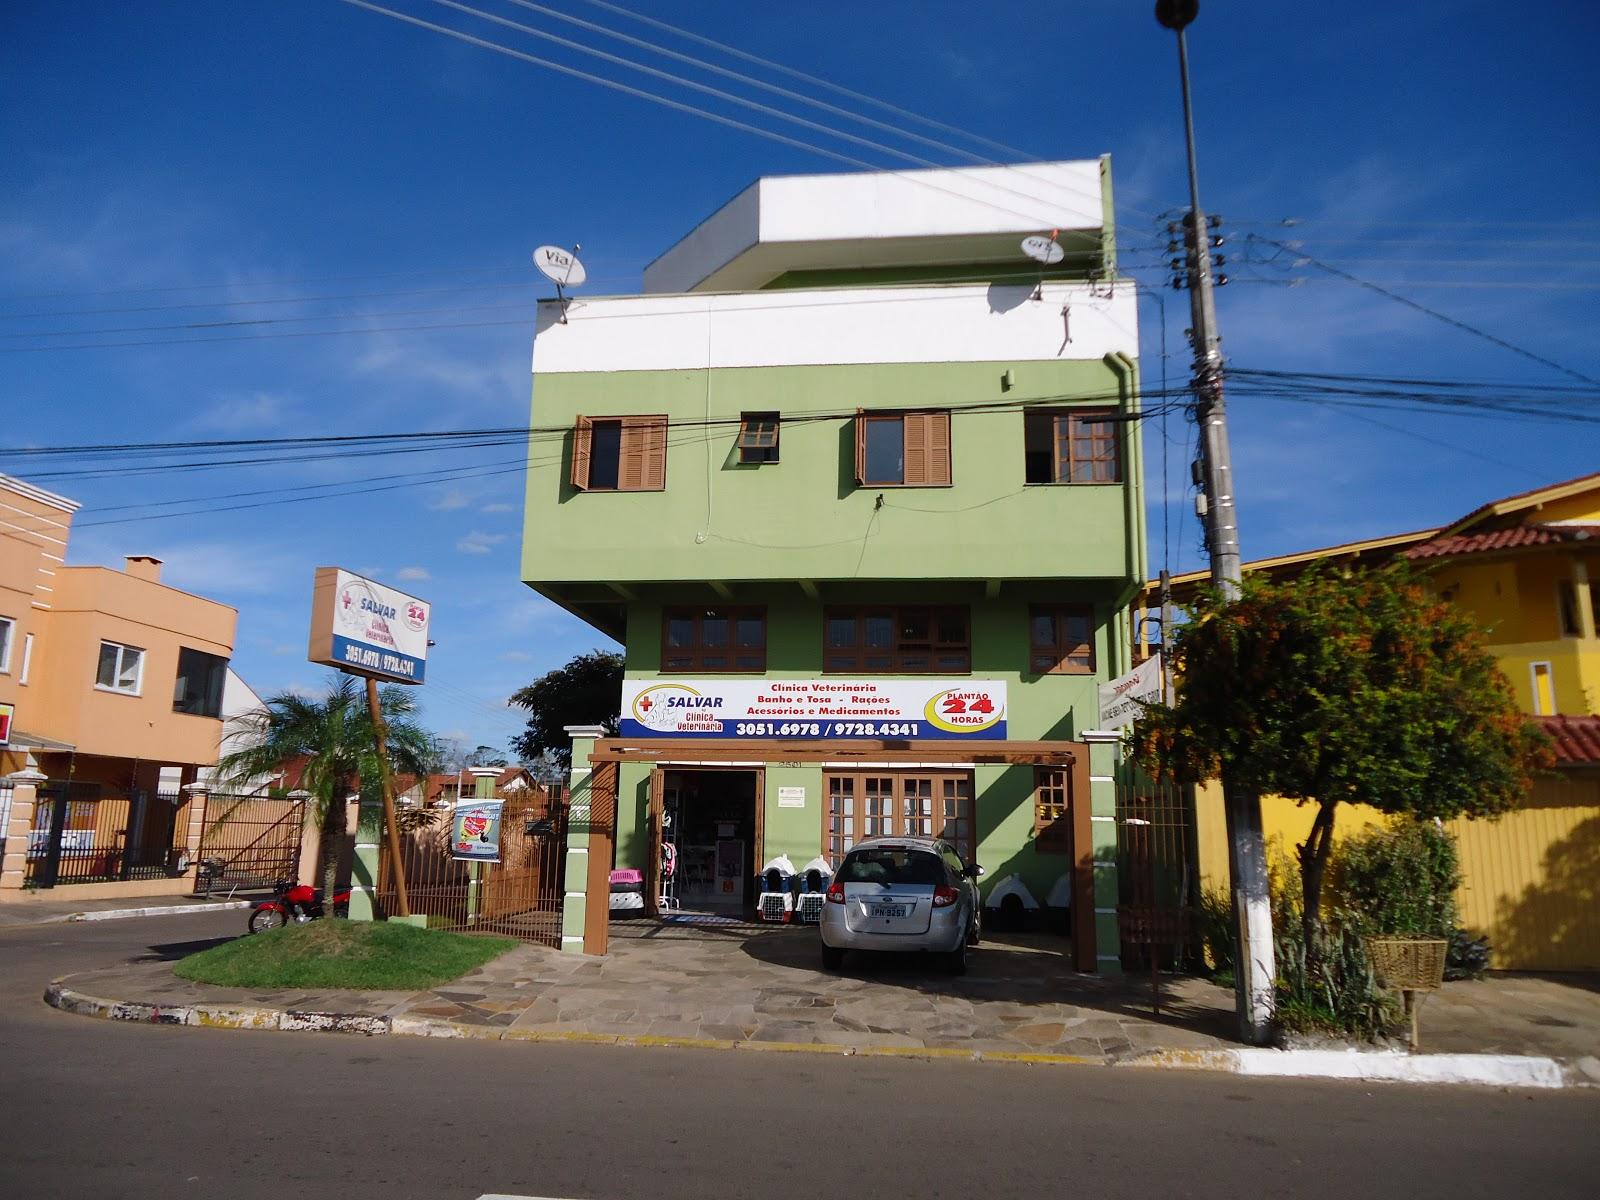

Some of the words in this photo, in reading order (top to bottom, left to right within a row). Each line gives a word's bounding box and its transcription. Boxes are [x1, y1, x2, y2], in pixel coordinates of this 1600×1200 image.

[545, 249, 569, 266] Via
[361, 598, 397, 621] SALVAR
[771, 683, 808, 692] Clínica
[812, 683, 877, 692] Veterinária
[667, 697, 723, 708] SALVAR
[757, 695, 793, 704] Banho
[806, 695, 832, 704] Tosa
[851, 695, 891, 706] Rações
[746, 706, 805, 716] Acessórios
[818, 706, 901, 716] Medicamentos
[942, 699, 995, 714] 24
[685, 712, 715, 722] Clínica
[951, 716, 984, 724] HORAS
[677, 722, 723, 731] Veterinária
[736, 723, 820, 736] 3051.6978
[834, 723, 918, 736] 9728.4341
